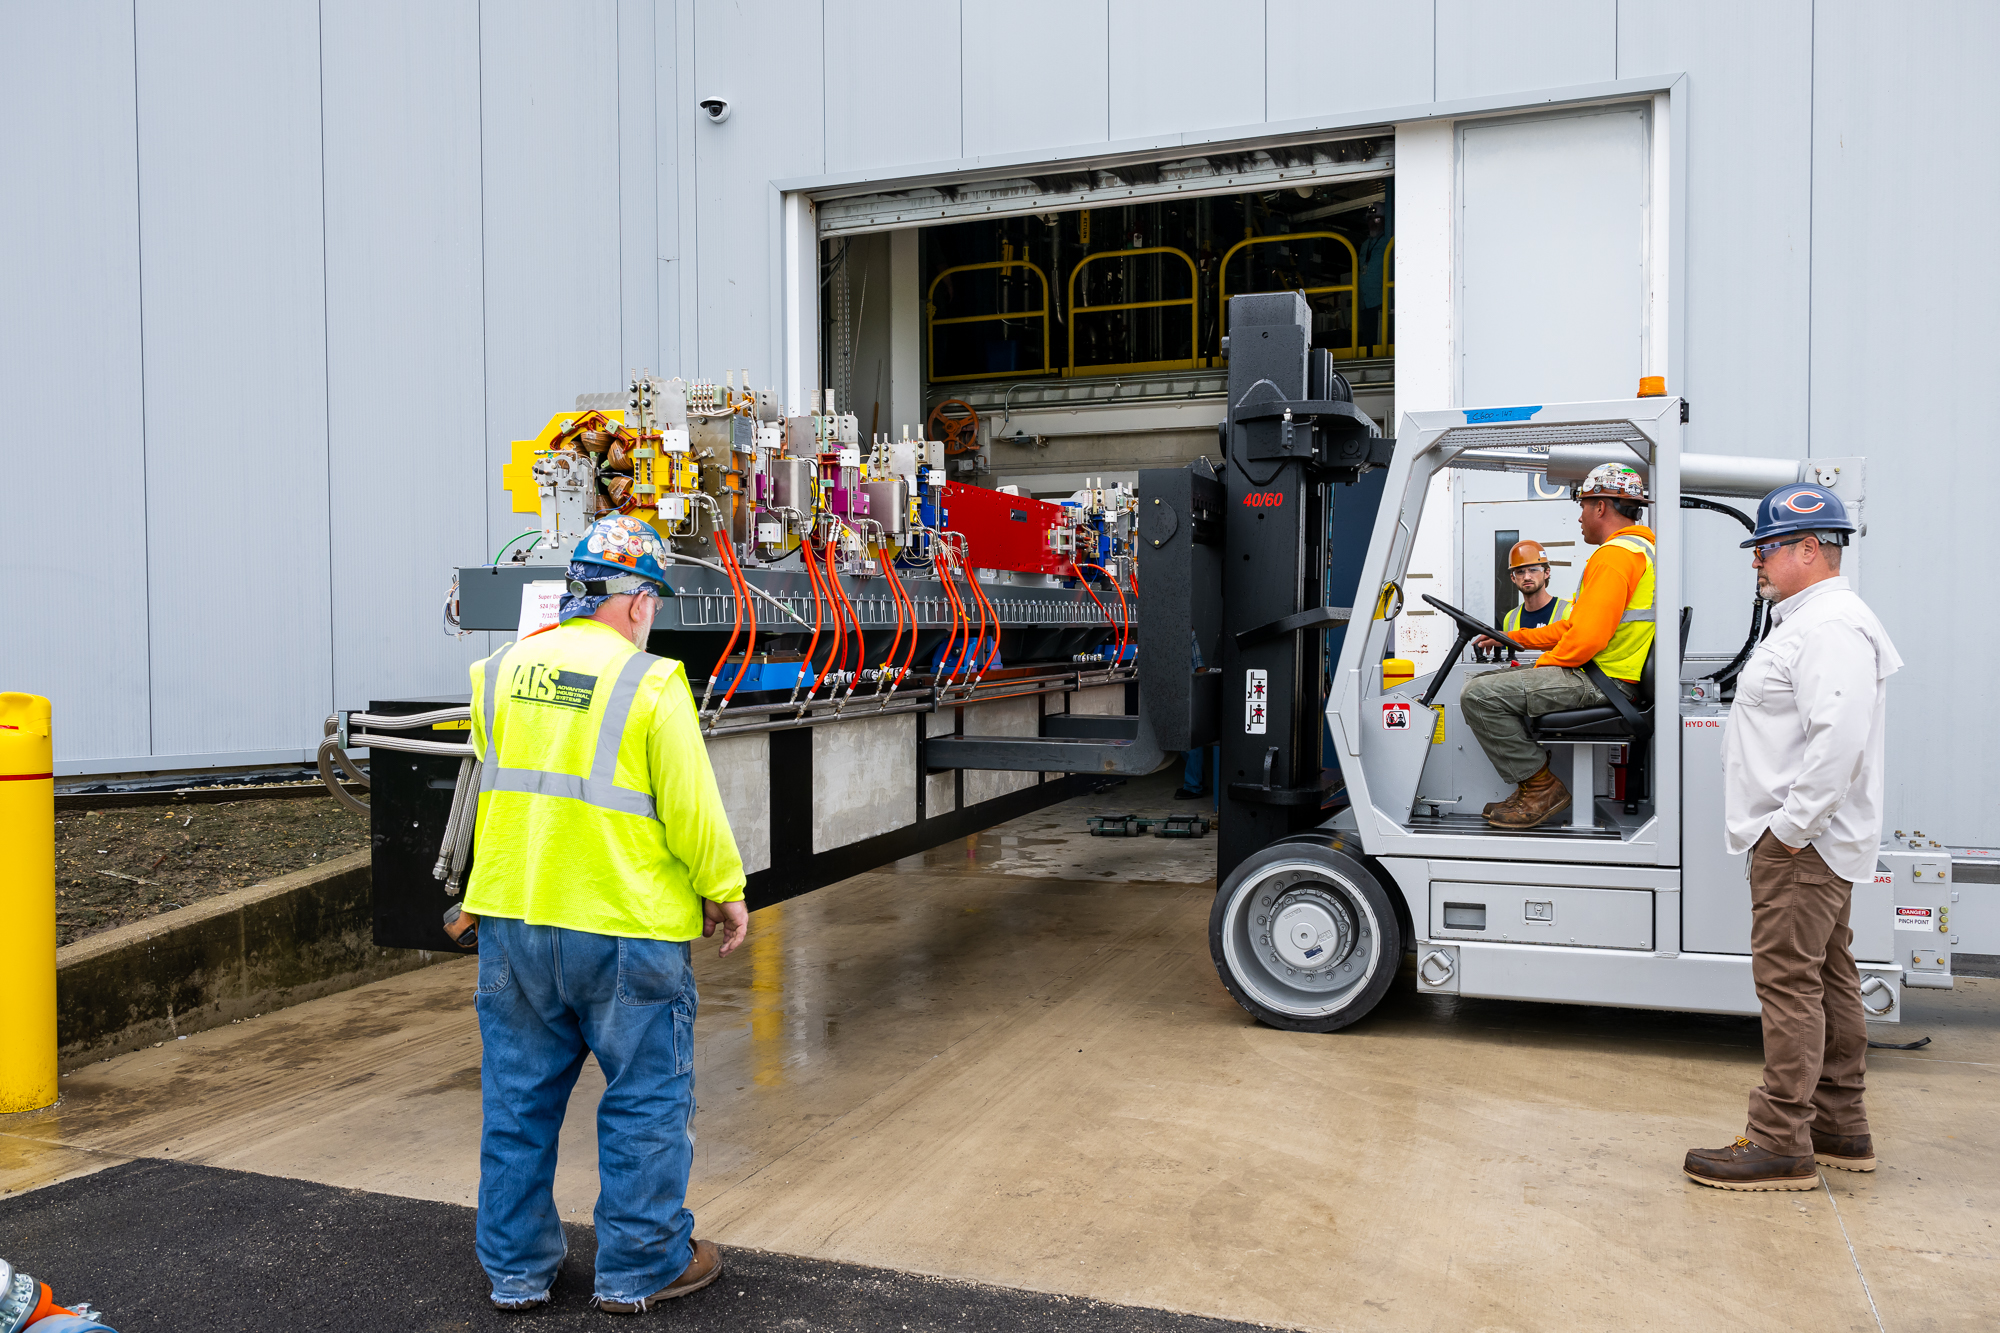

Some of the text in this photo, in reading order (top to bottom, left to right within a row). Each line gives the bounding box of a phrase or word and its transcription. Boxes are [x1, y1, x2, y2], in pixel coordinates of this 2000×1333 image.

[1242, 492, 1284, 507] 40/60
[557, 685, 592, 694] ADVANTAGE
[556, 690, 590, 700] INDUSTRIAL
[556, 694, 581, 702] SYSTEMS
[1685, 720, 1720, 728] HYD OIL
